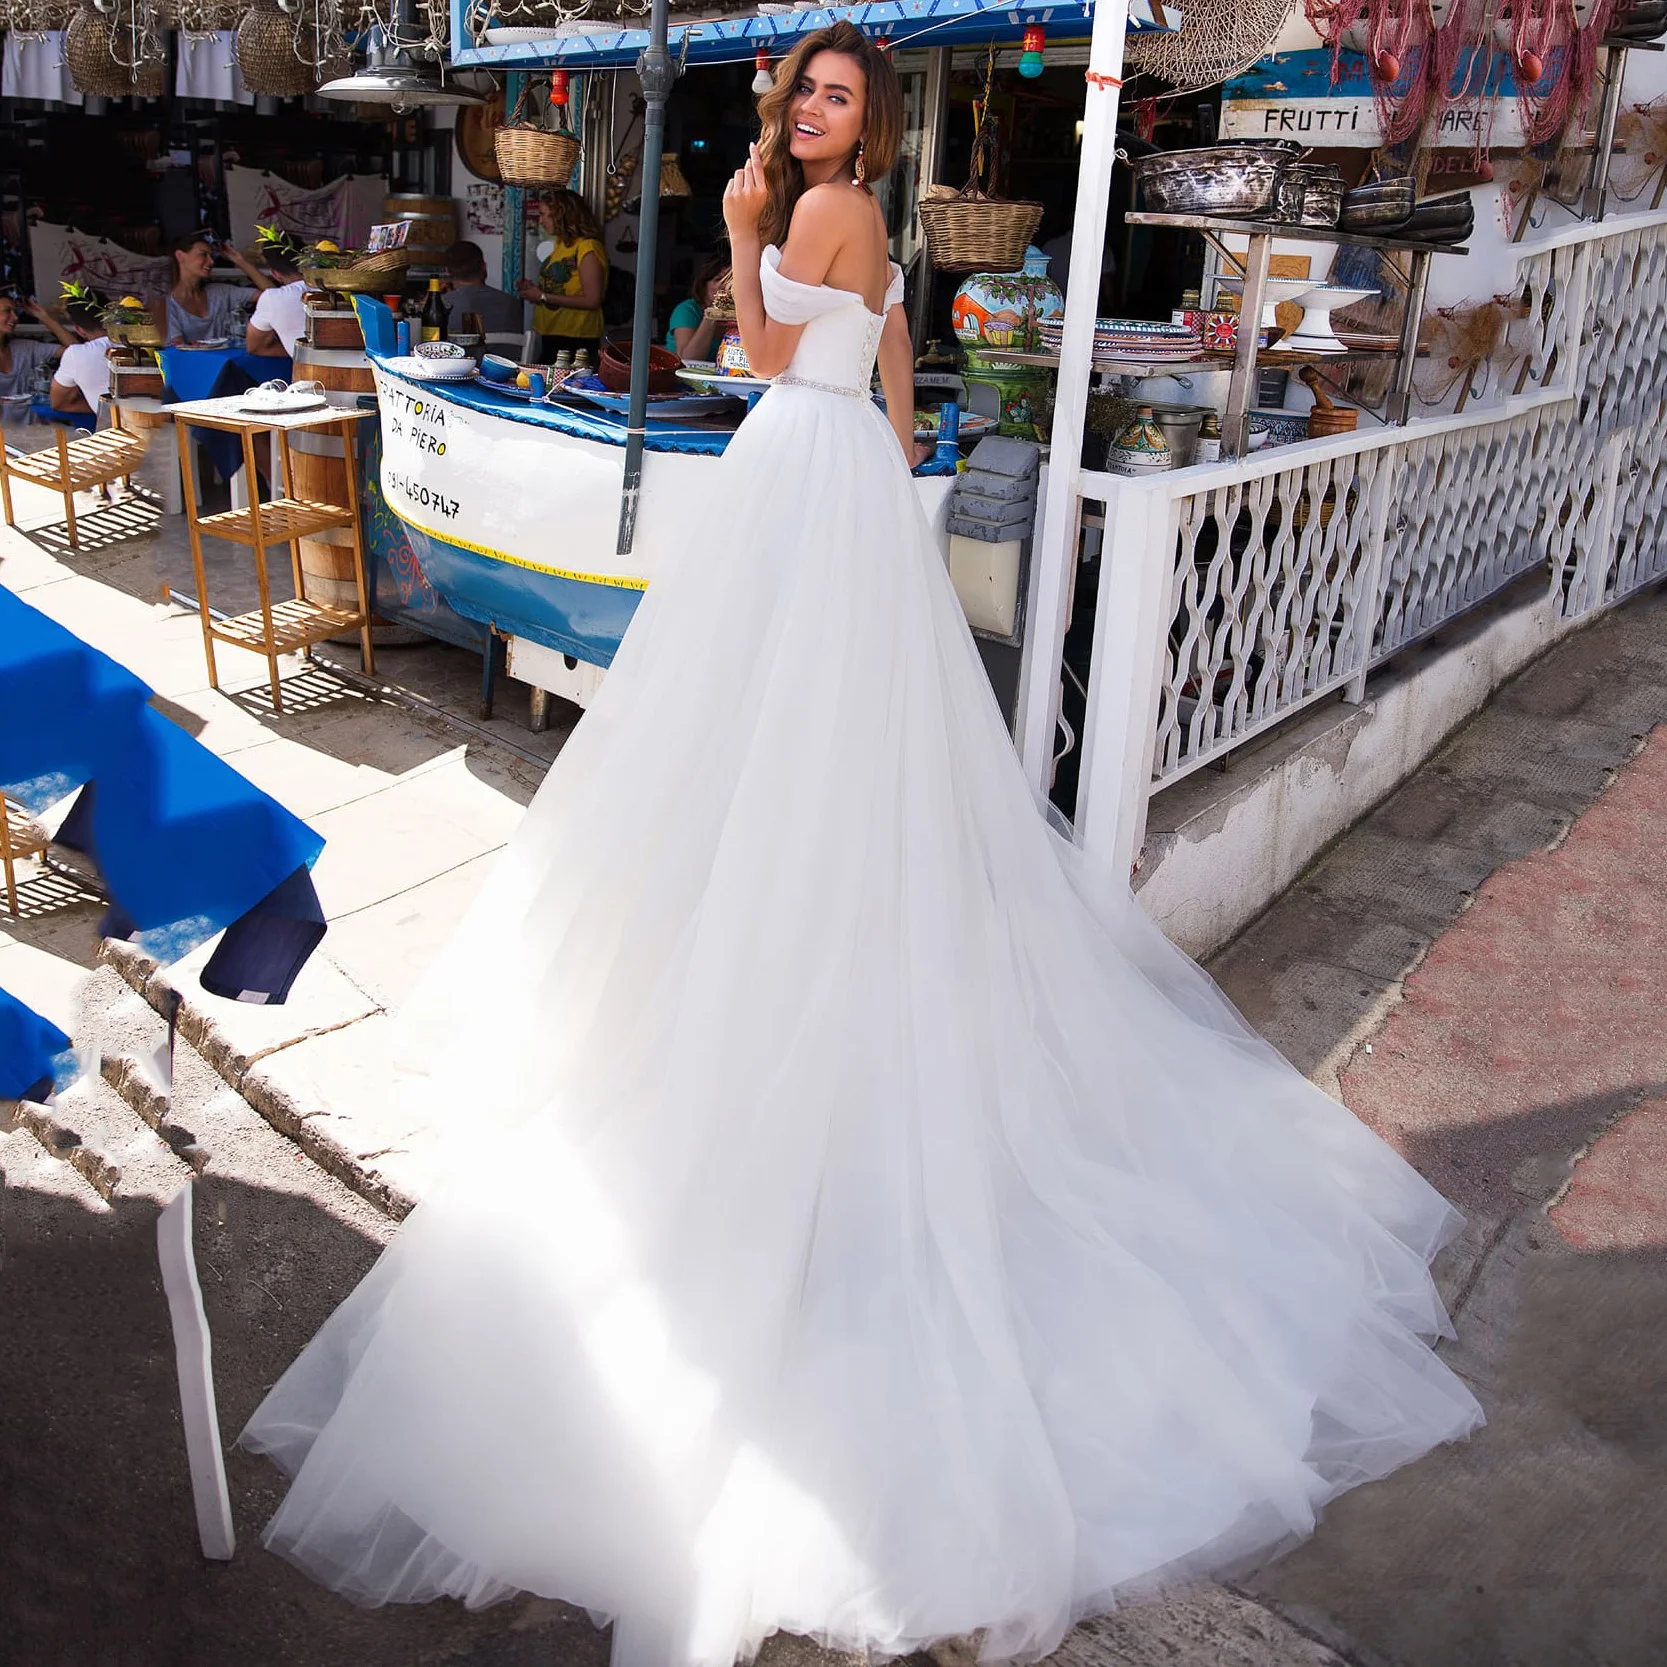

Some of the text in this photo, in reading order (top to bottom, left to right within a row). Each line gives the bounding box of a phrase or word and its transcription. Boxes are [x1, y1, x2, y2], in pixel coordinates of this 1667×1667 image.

[1264, 106, 1359, 133] FRUTTI
[1440, 109, 1488, 132] ARE
[391, 417, 447, 456] DA PIERO
